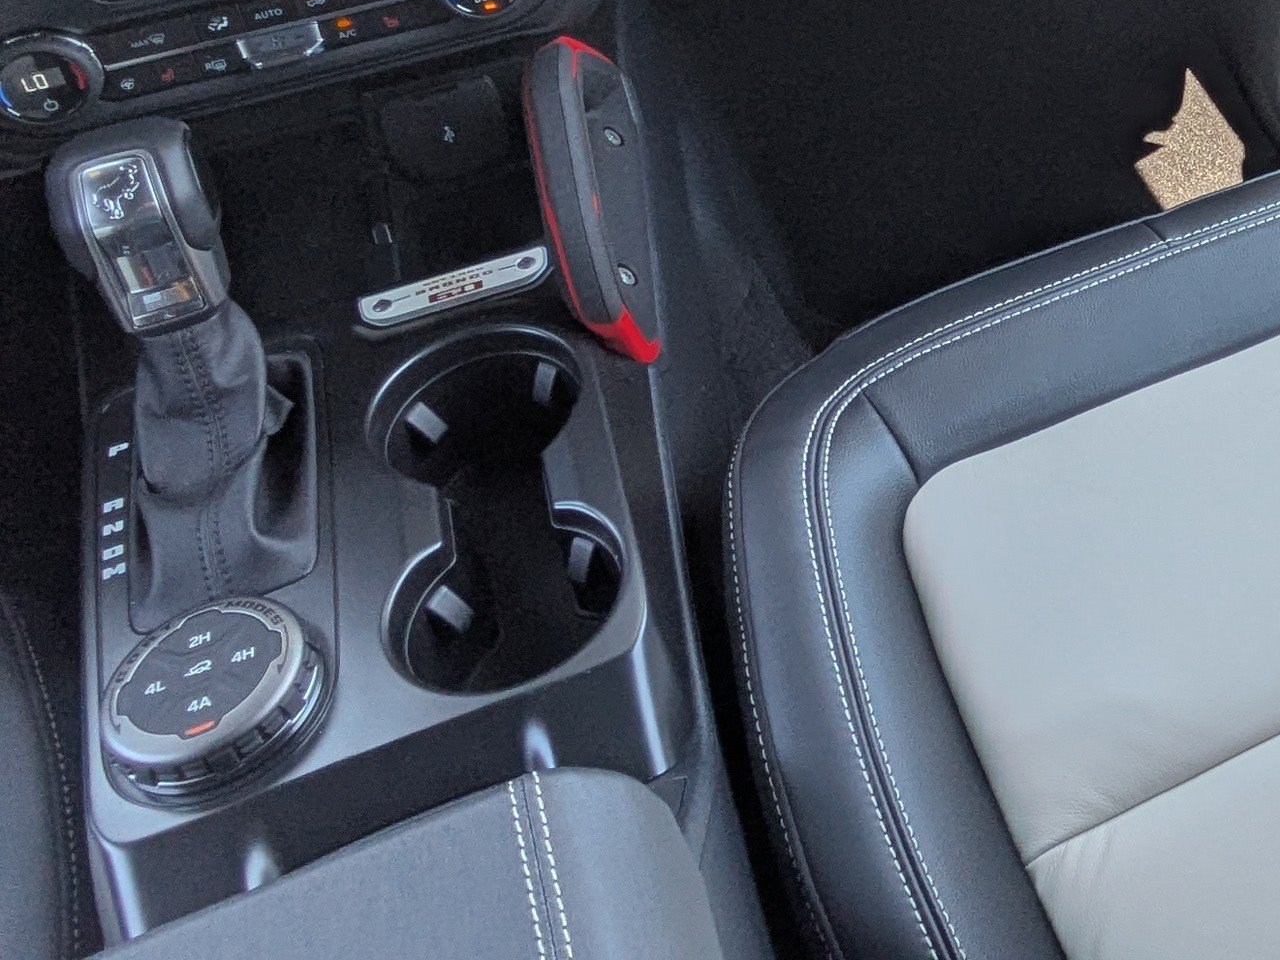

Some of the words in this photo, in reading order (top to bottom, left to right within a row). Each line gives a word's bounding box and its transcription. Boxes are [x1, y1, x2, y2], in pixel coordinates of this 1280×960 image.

[255, 8, 283, 20] AUTO
[338, 29, 357, 39] A/C
[21, 74, 50, 93] LO
[108, 442, 129, 458] P
[103, 498, 124, 513] R
[103, 520, 124, 536] N
[103, 544, 124, 561] D
[103, 562, 126, 580] M
[224, 600, 284, 626] MODES
[188, 632, 211, 649] 2H
[231, 647, 256, 664] 4H
[145, 681, 166, 695] 4L
[187, 695, 212, 712] 4A
